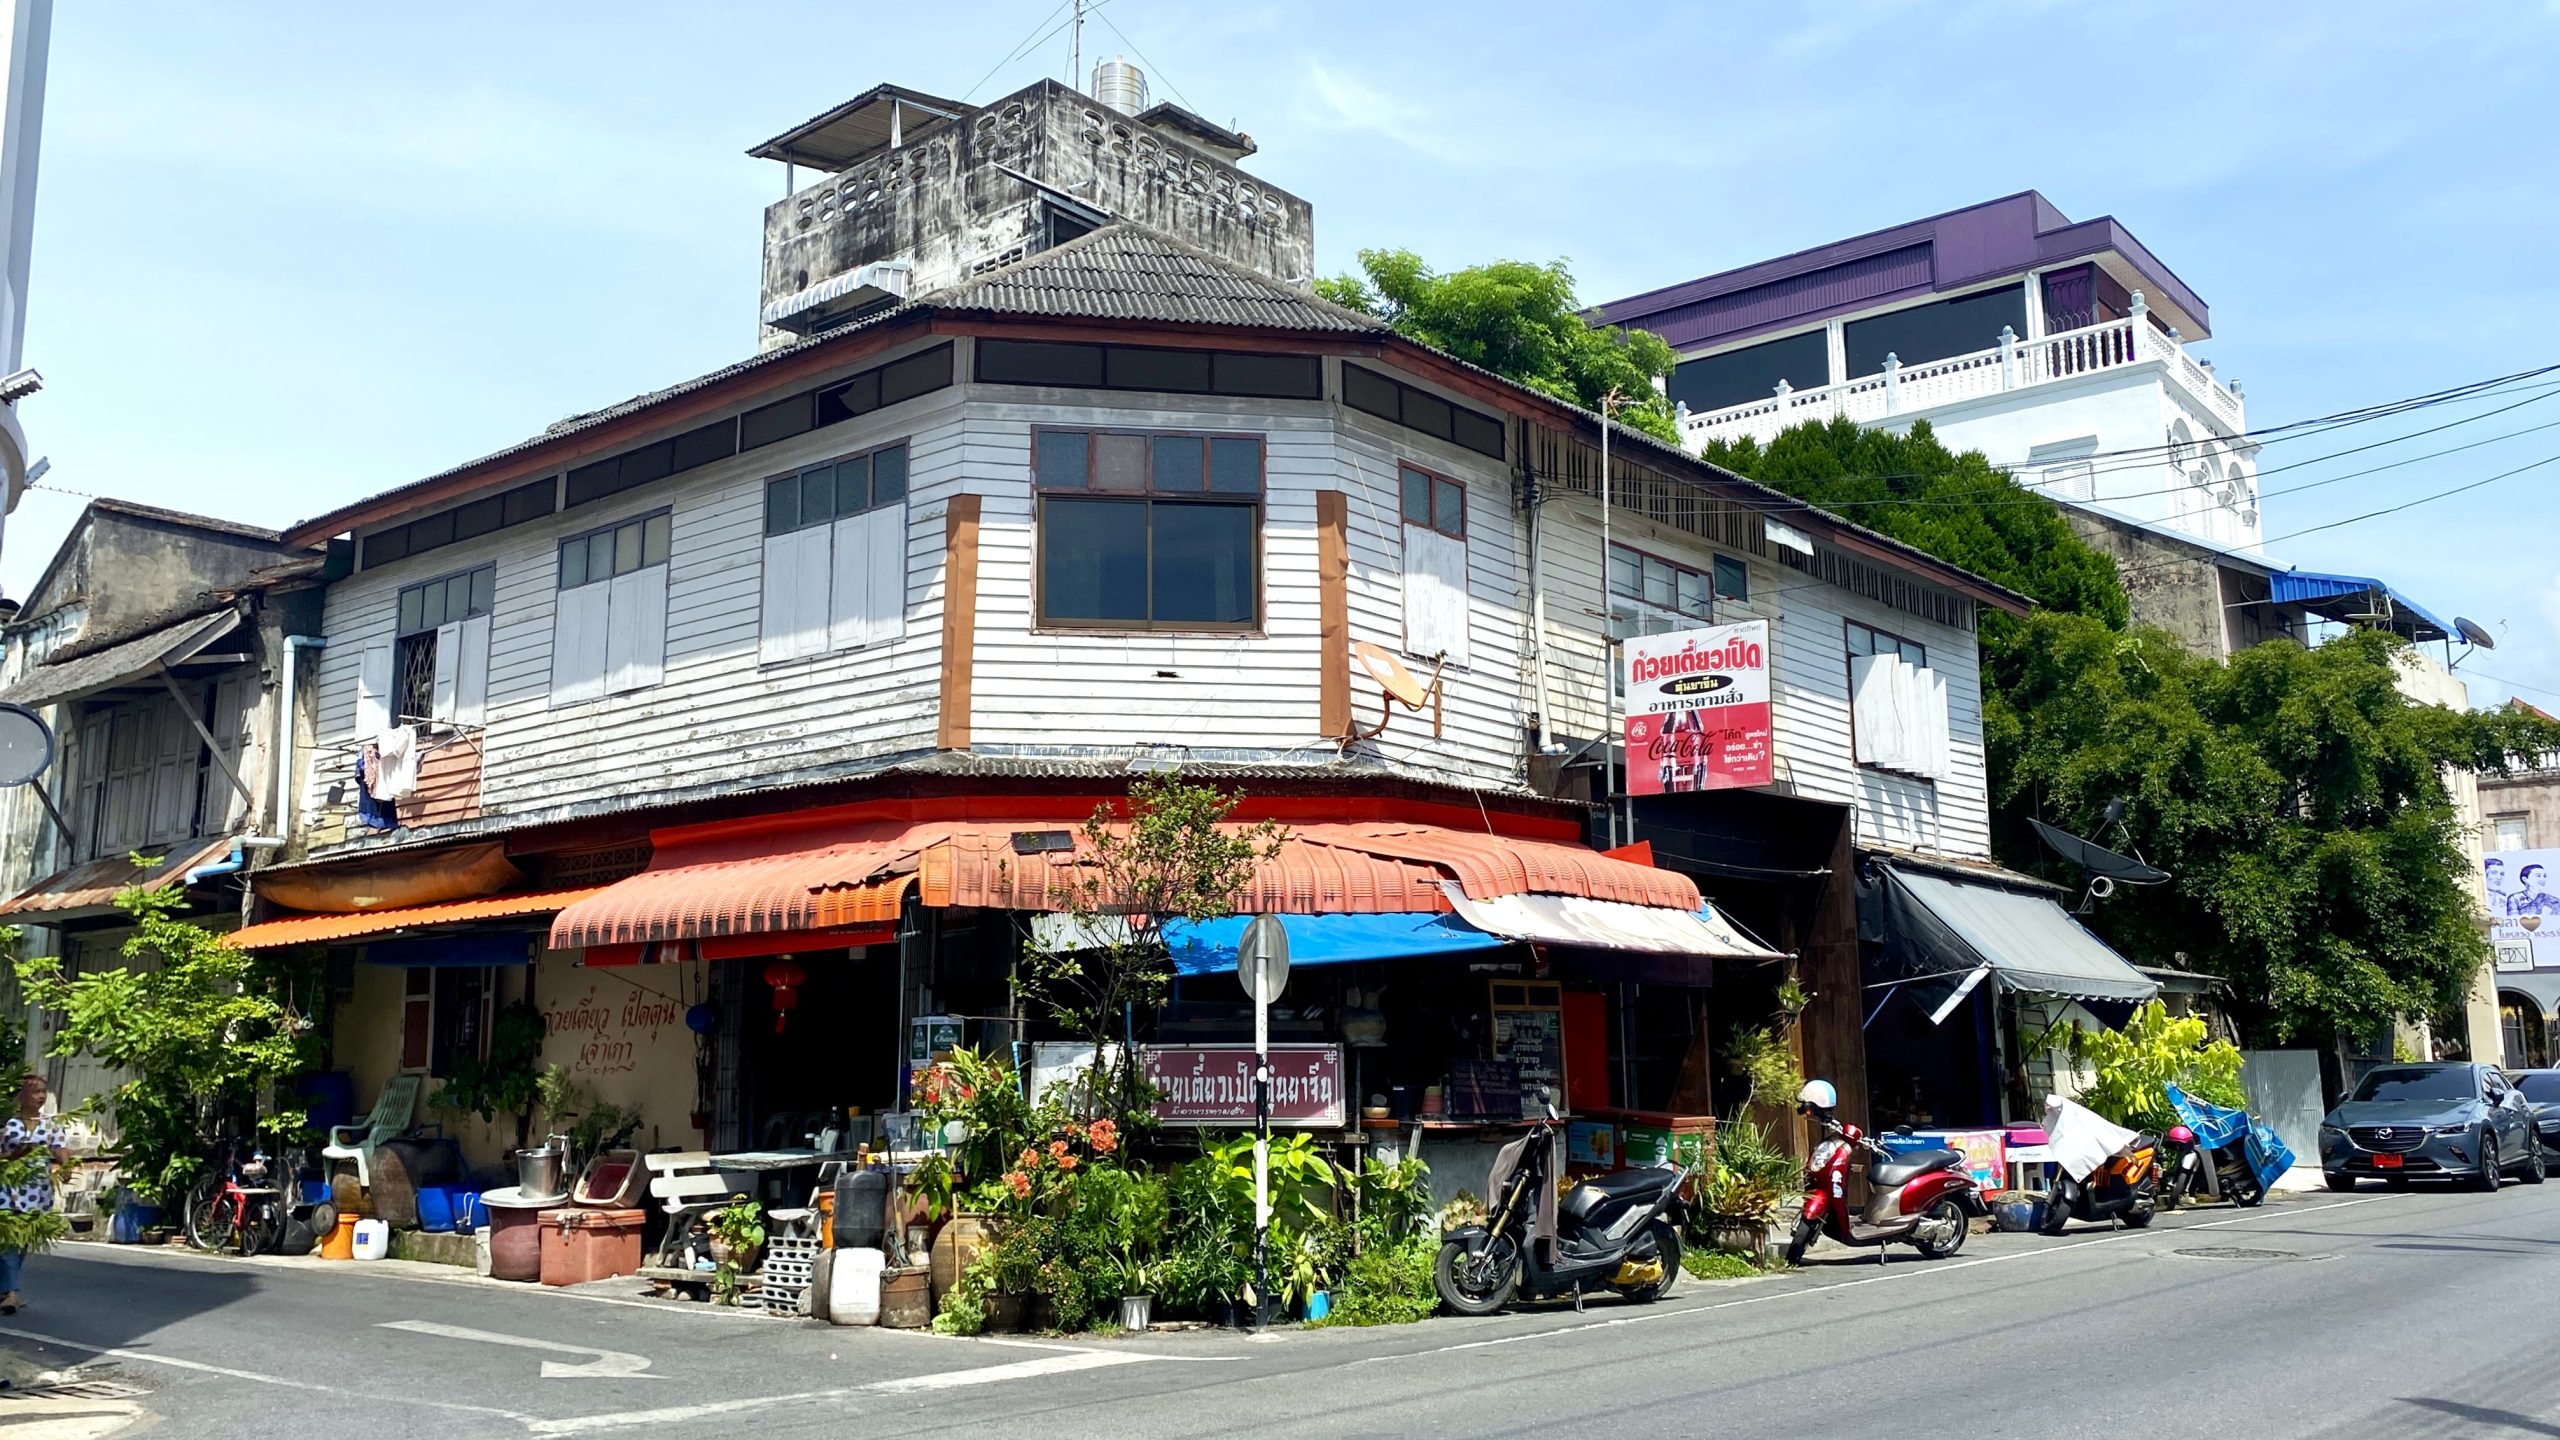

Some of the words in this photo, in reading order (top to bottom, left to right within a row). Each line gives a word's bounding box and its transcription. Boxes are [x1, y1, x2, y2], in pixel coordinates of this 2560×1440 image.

[1632, 636, 1762, 684] ก๋วยเตี๋ยวเป็ด
[1674, 676, 1719, 695] ตุ๋นยาจีน
[1649, 688, 1744, 712] อาหารตามสั่ง
[934, 1034, 958, 1043] Chang
